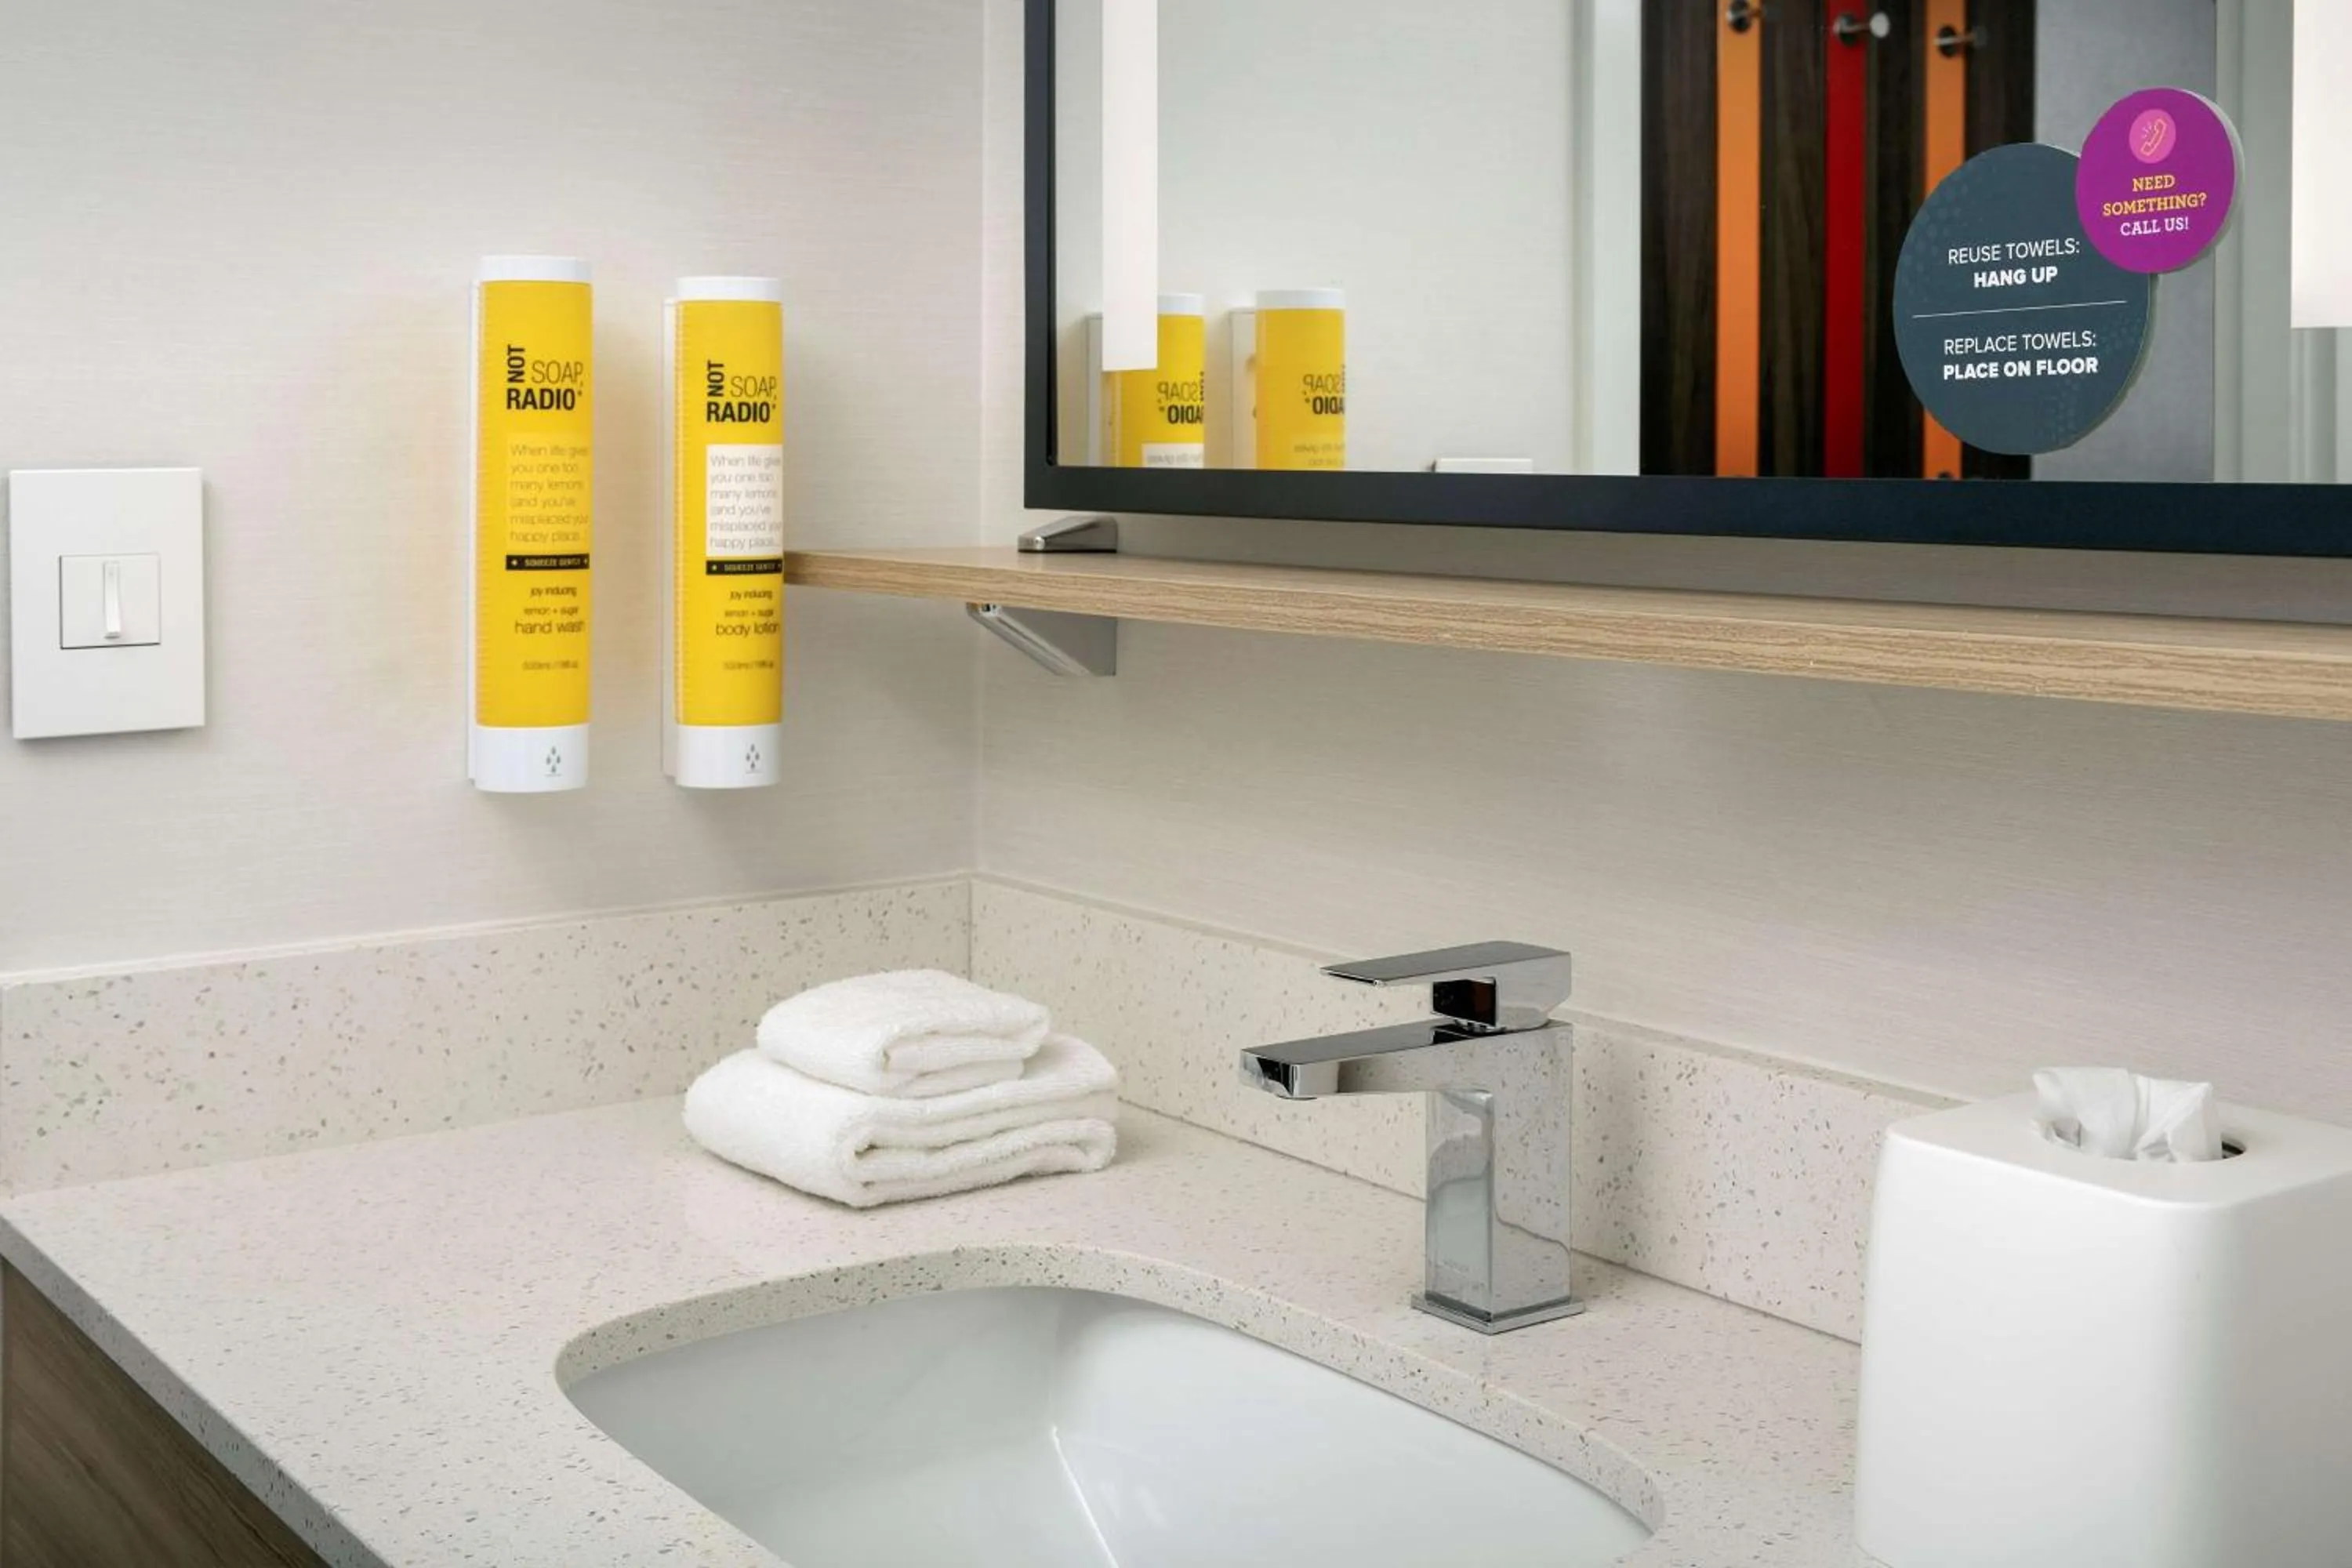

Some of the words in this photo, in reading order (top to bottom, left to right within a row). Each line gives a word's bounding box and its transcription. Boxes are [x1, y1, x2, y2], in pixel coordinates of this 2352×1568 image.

[2132, 175, 2176, 192] NEED
[2103, 192, 2207, 216] SOMETHING?
[2120, 220, 2161, 236] CALL
[2165, 216, 2189, 231] US!
[1948, 245, 2001, 264] REUSE
[2005, 238, 2080, 260] TOWELS:
[1973, 269, 2027, 288] HANG
[2031, 266, 2058, 283] UP
[1944, 335, 2017, 355] REPLACE
[2022, 330, 2096, 350] TOWELS:
[507, 343, 525, 383] NOT
[1943, 362, 1999, 380] PLACE
[2003, 360, 2031, 377] ON
[2036, 357, 2099, 376] FLOOR
[706, 359, 724, 397] NOT
[510, 444, 547, 456] When
[510, 463, 534, 475] you
[536, 463, 561, 473] one
[710, 455, 745, 468] When
[510, 480, 543, 493] many
[710, 473, 733, 485] you
[710, 488, 742, 503] many
[510, 530, 547, 543] happy
[710, 535, 746, 551] happy
[514, 621, 553, 634] hand
[715, 622, 750, 637] body
